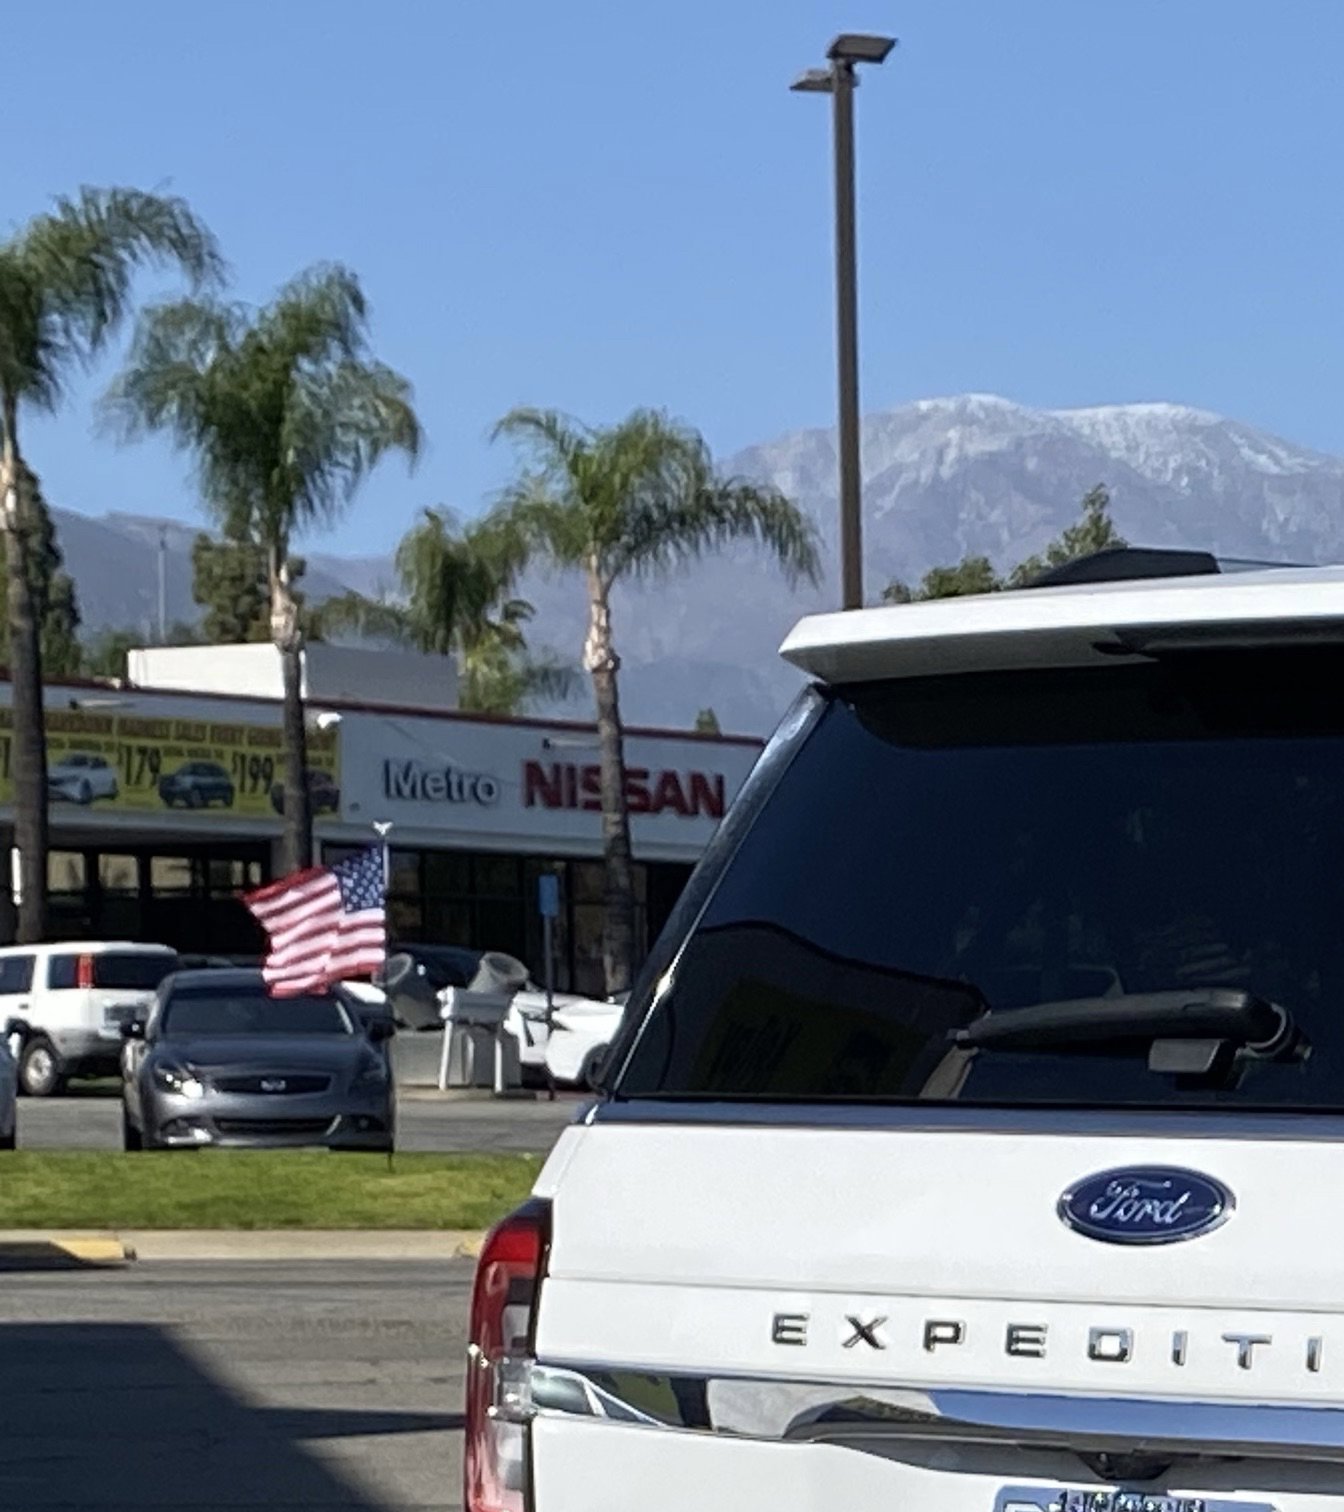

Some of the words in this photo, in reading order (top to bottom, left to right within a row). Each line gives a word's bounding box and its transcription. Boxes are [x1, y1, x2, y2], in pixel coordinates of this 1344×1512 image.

[383, 757, 499, 806] Metro
[521, 757, 726, 819] NISSAN
[1089, 1179, 1187, 1226] Ford
